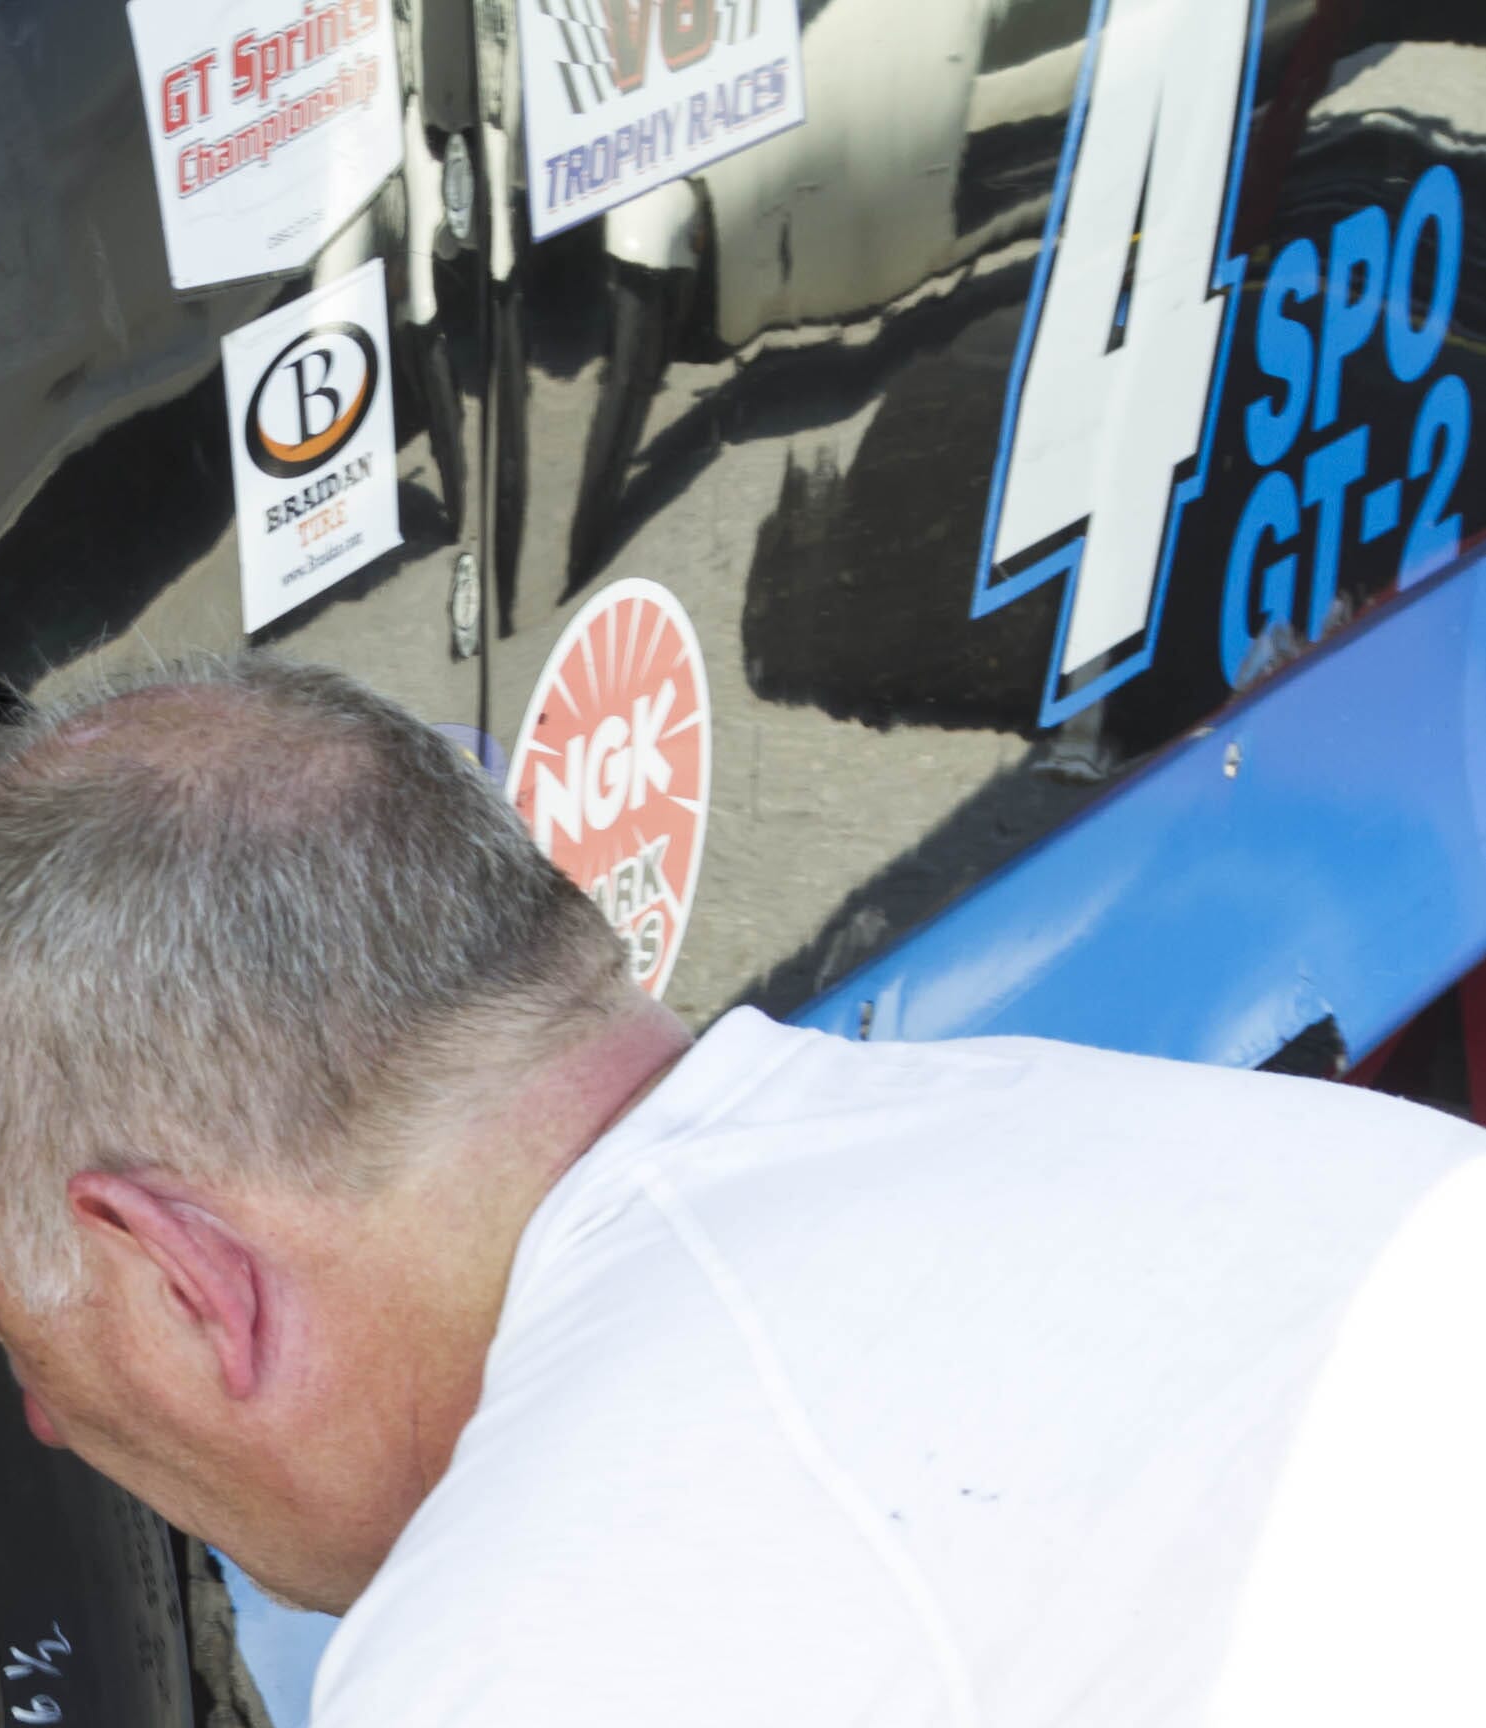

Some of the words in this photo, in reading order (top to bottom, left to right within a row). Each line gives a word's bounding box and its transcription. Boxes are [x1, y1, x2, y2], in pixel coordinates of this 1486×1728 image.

[162, 48, 216, 139] GT
[178, 54, 379, 199] Championship
[544, 101, 681, 213] TROPHY
[687, 57, 789, 151] RACES
[970, 0, 1266, 729] 4
[1245, 164, 1463, 466] SPO
[266, 452, 372, 534] BRAIDAN
[296, 501, 348, 547] TIRE
[1220, 375, 1471, 688] GT-2
[535, 678, 677, 862] NGK
